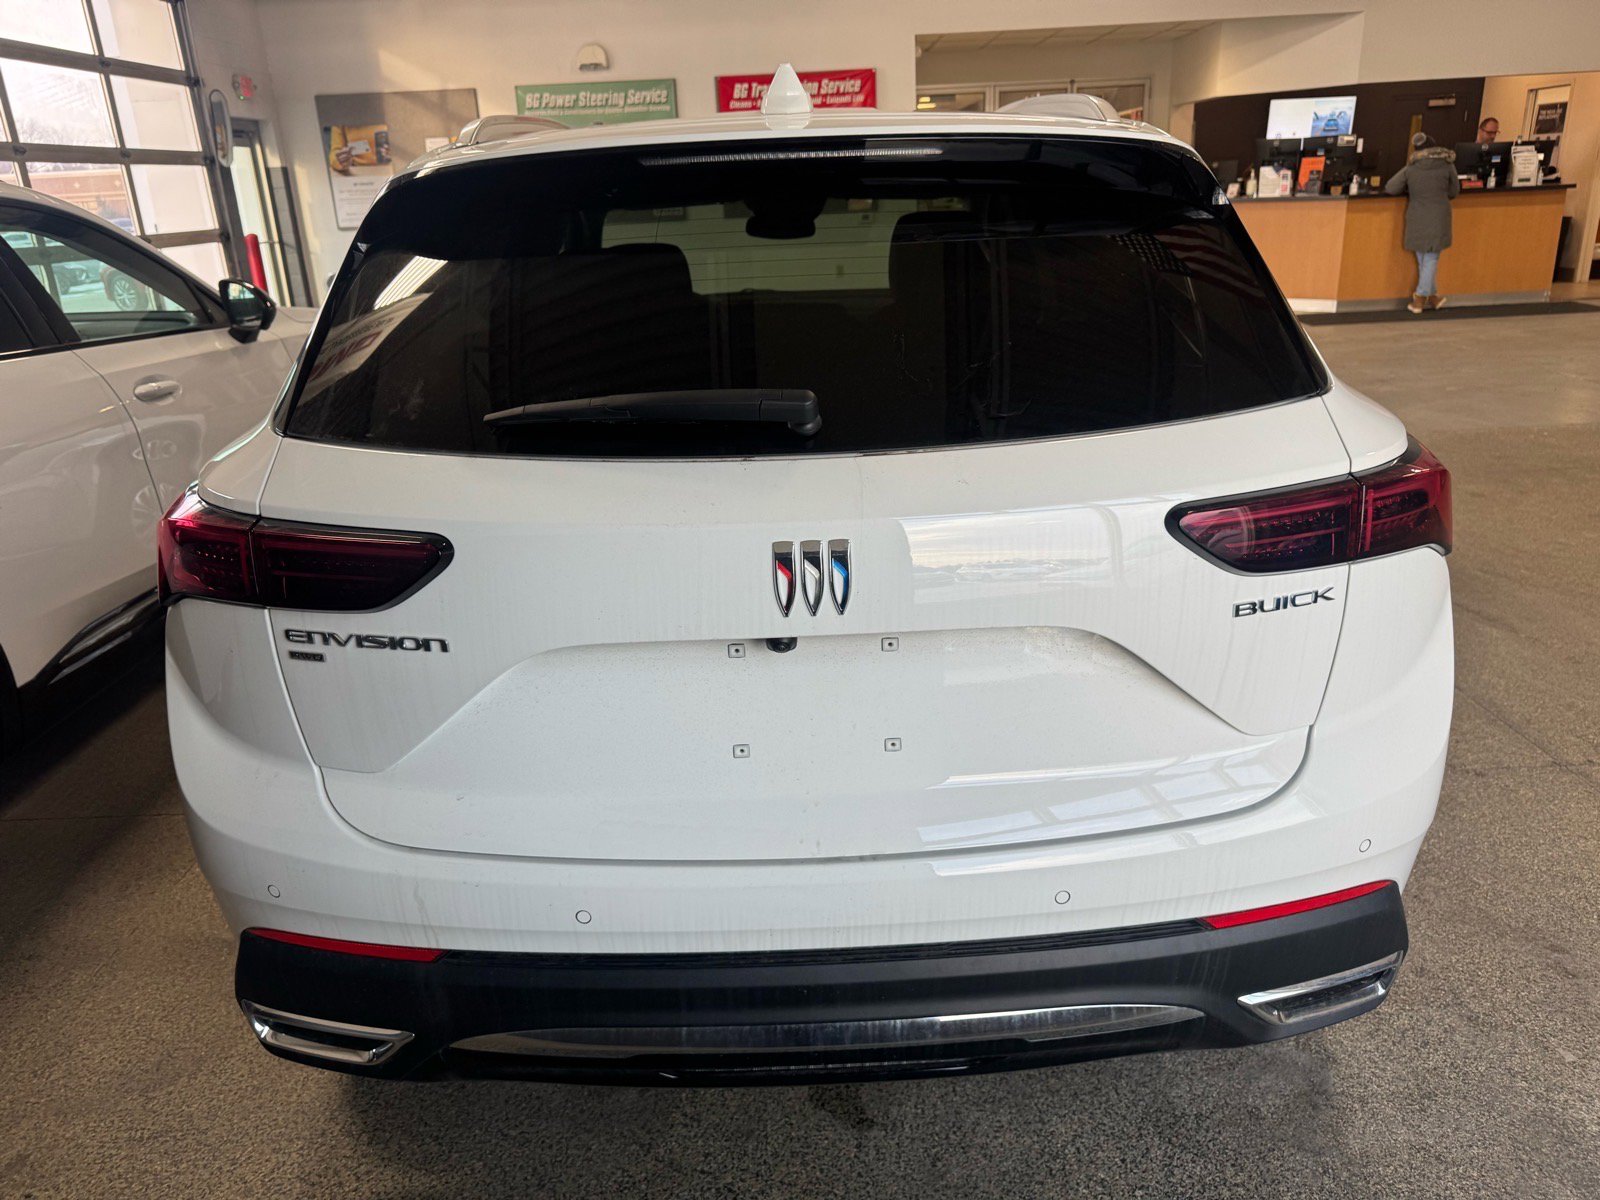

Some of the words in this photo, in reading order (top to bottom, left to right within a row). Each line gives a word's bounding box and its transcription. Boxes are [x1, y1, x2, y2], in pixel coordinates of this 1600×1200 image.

[525, 92, 540, 109] BG
[541, 92, 577, 108] Power
[578, 89, 625, 108] Steering
[626, 87, 668, 104] Service
[733, 82, 749, 99] BG
[820, 77, 862, 95] Service
[1232, 586, 1335, 618] BUICK
